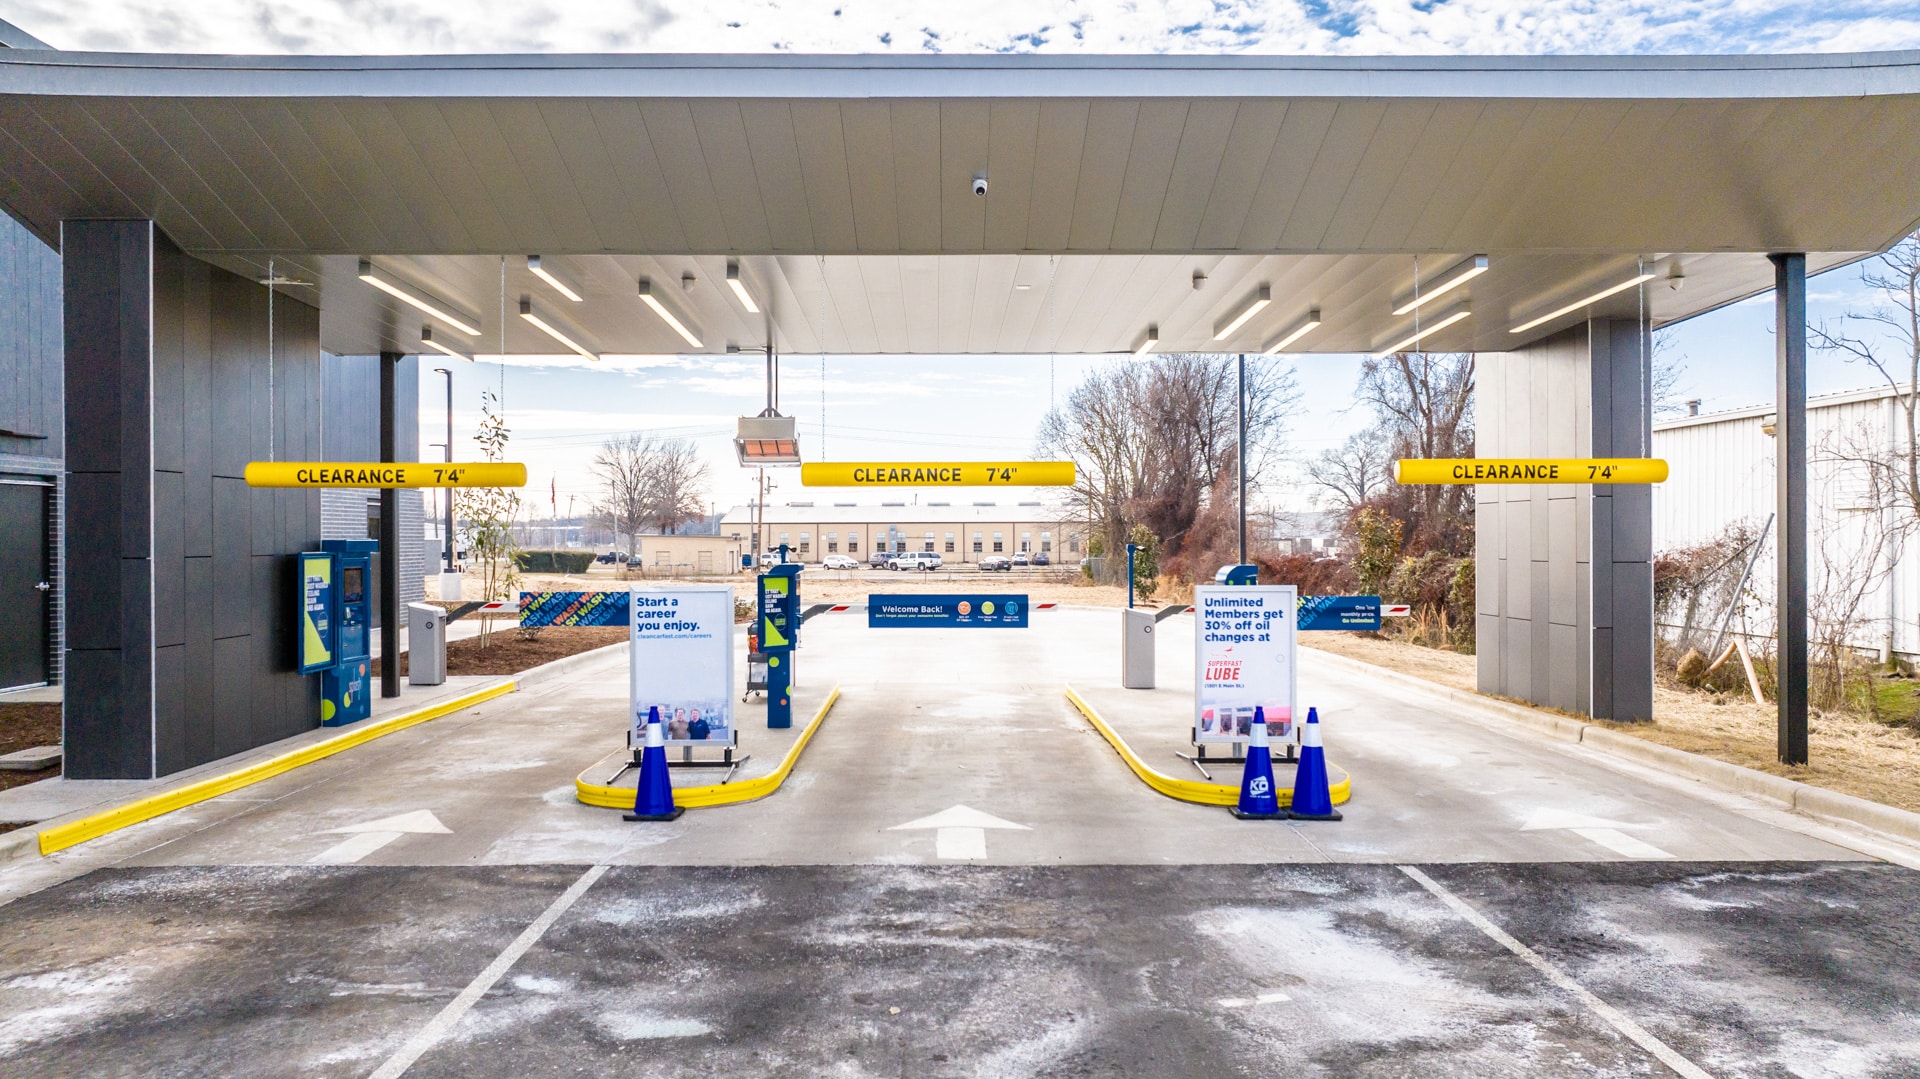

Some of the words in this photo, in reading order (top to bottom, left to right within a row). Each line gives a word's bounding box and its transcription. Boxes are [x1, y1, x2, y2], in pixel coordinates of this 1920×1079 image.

[297, 470, 406, 483] CLEARANCE
[434, 469, 465, 483] 7'4"
[854, 468, 961, 482] CLEARANCE
[986, 468, 1017, 482] 7'4"
[1453, 465, 1558, 479] CLEARANCE
[1588, 465, 1618, 479] 7'4"
[577, 592, 605, 616] WASH
[637, 597, 668, 606] Start
[1205, 598, 1263, 606] Unlimited
[553, 601, 580, 625] WASH
[1205, 610, 1260, 618] Members
[1263, 610, 1283, 620] get
[638, 622, 660, 632] you
[664, 620, 700, 632] enjoy.
[1205, 621, 1231, 630] 30%
[1235, 621, 1252, 630] off
[1255, 621, 1270, 630] oil
[1205, 632, 1254, 643] changes
[1258, 633, 1270, 641] at
[1206, 668, 1240, 680] LUBE
